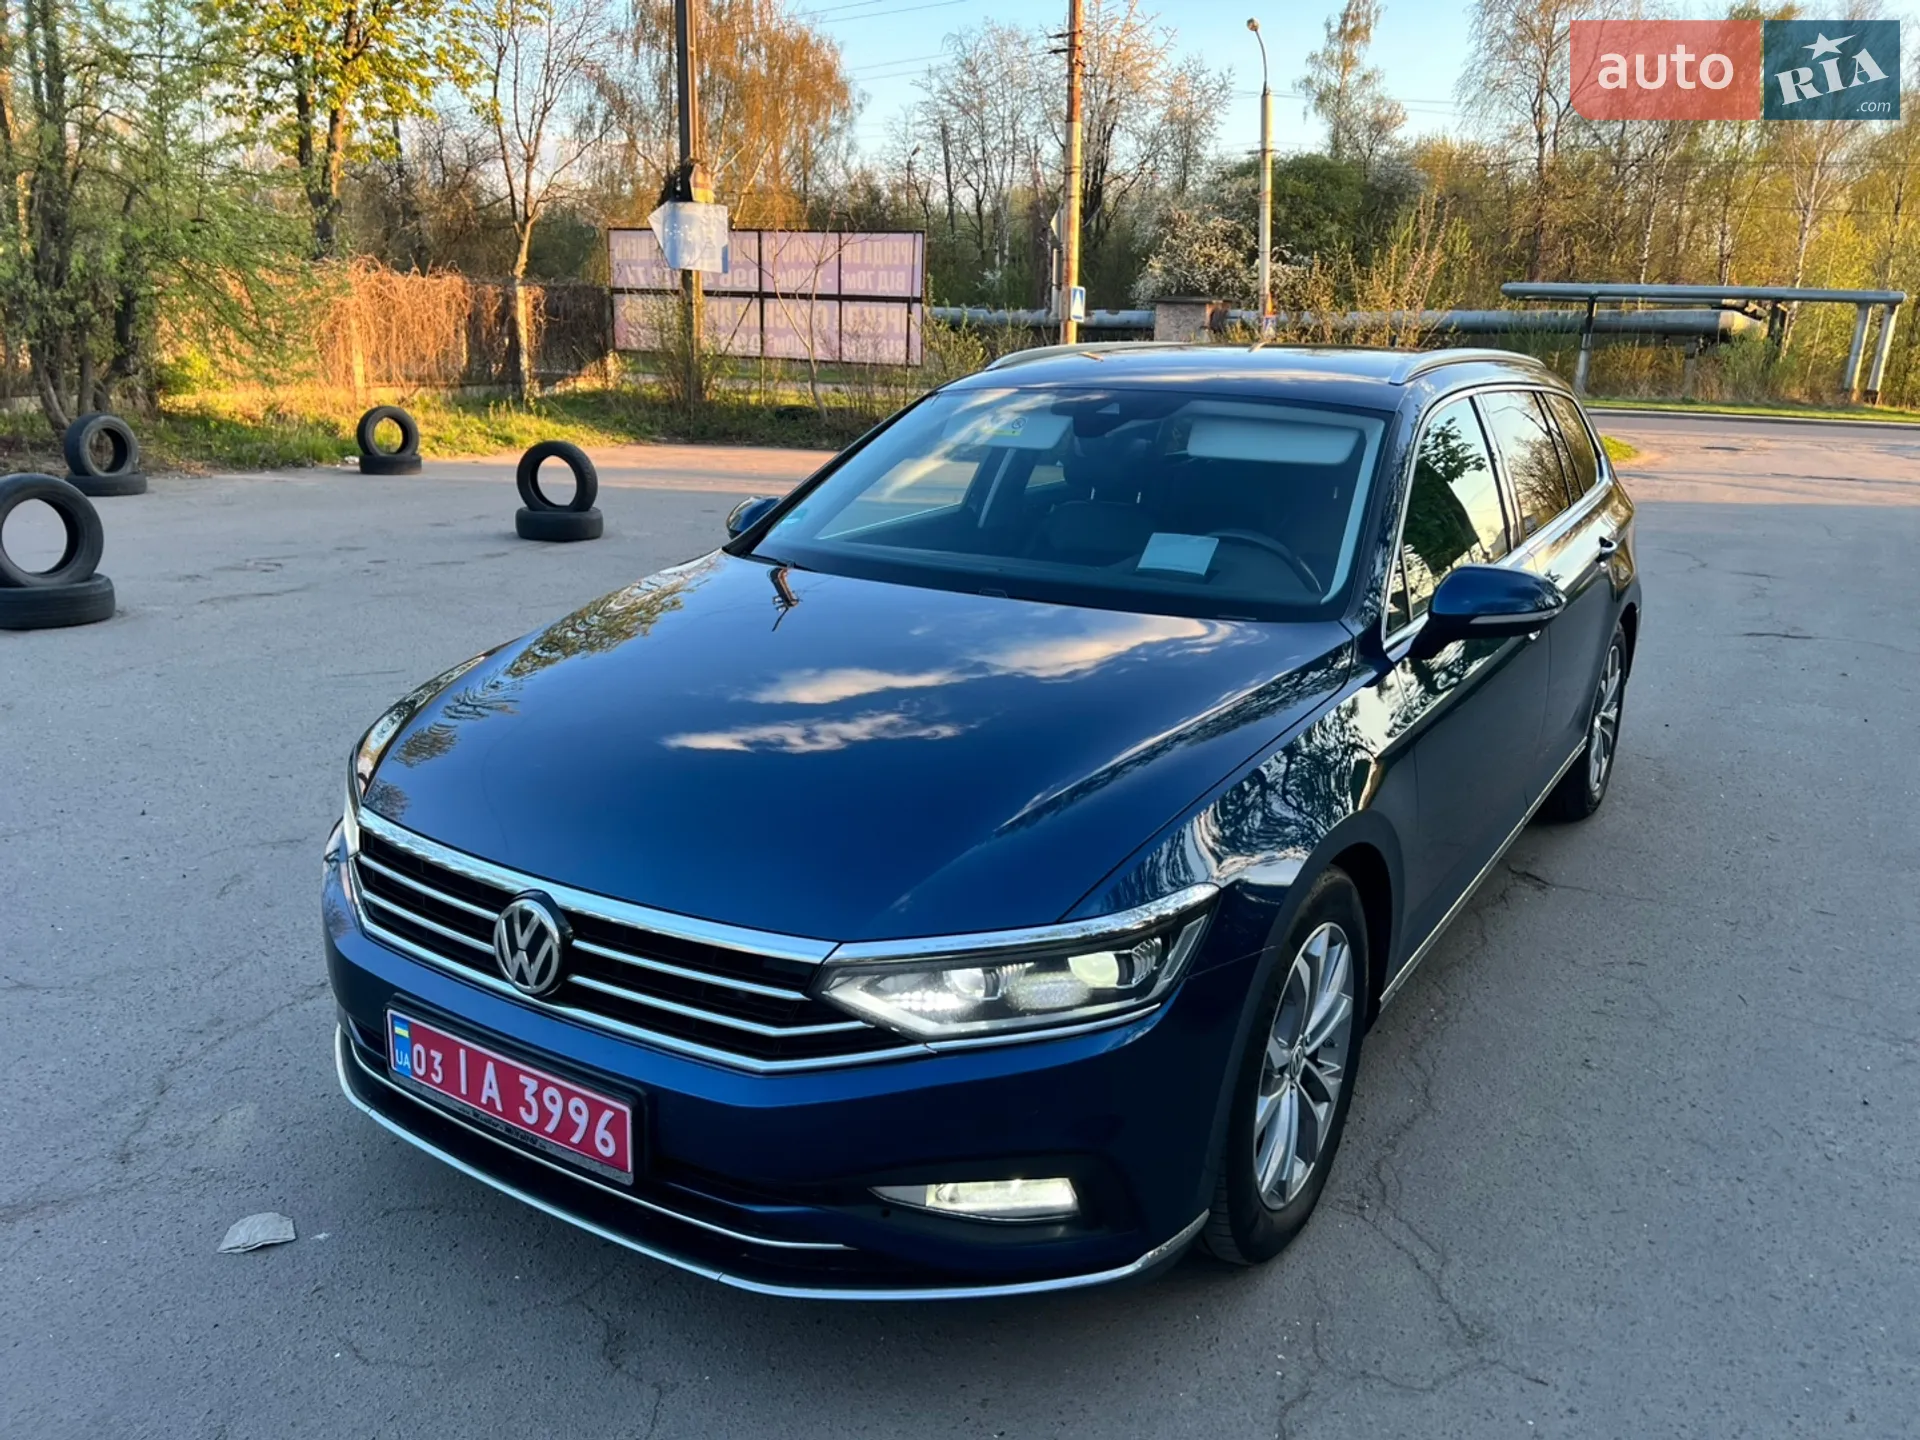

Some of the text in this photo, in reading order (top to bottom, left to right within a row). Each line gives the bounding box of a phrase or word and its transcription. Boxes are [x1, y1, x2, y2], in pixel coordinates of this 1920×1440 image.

[395, 1048, 411, 1070] UA
[412, 1043, 444, 1084] 03
[518, 1074, 616, 1158] 3996
